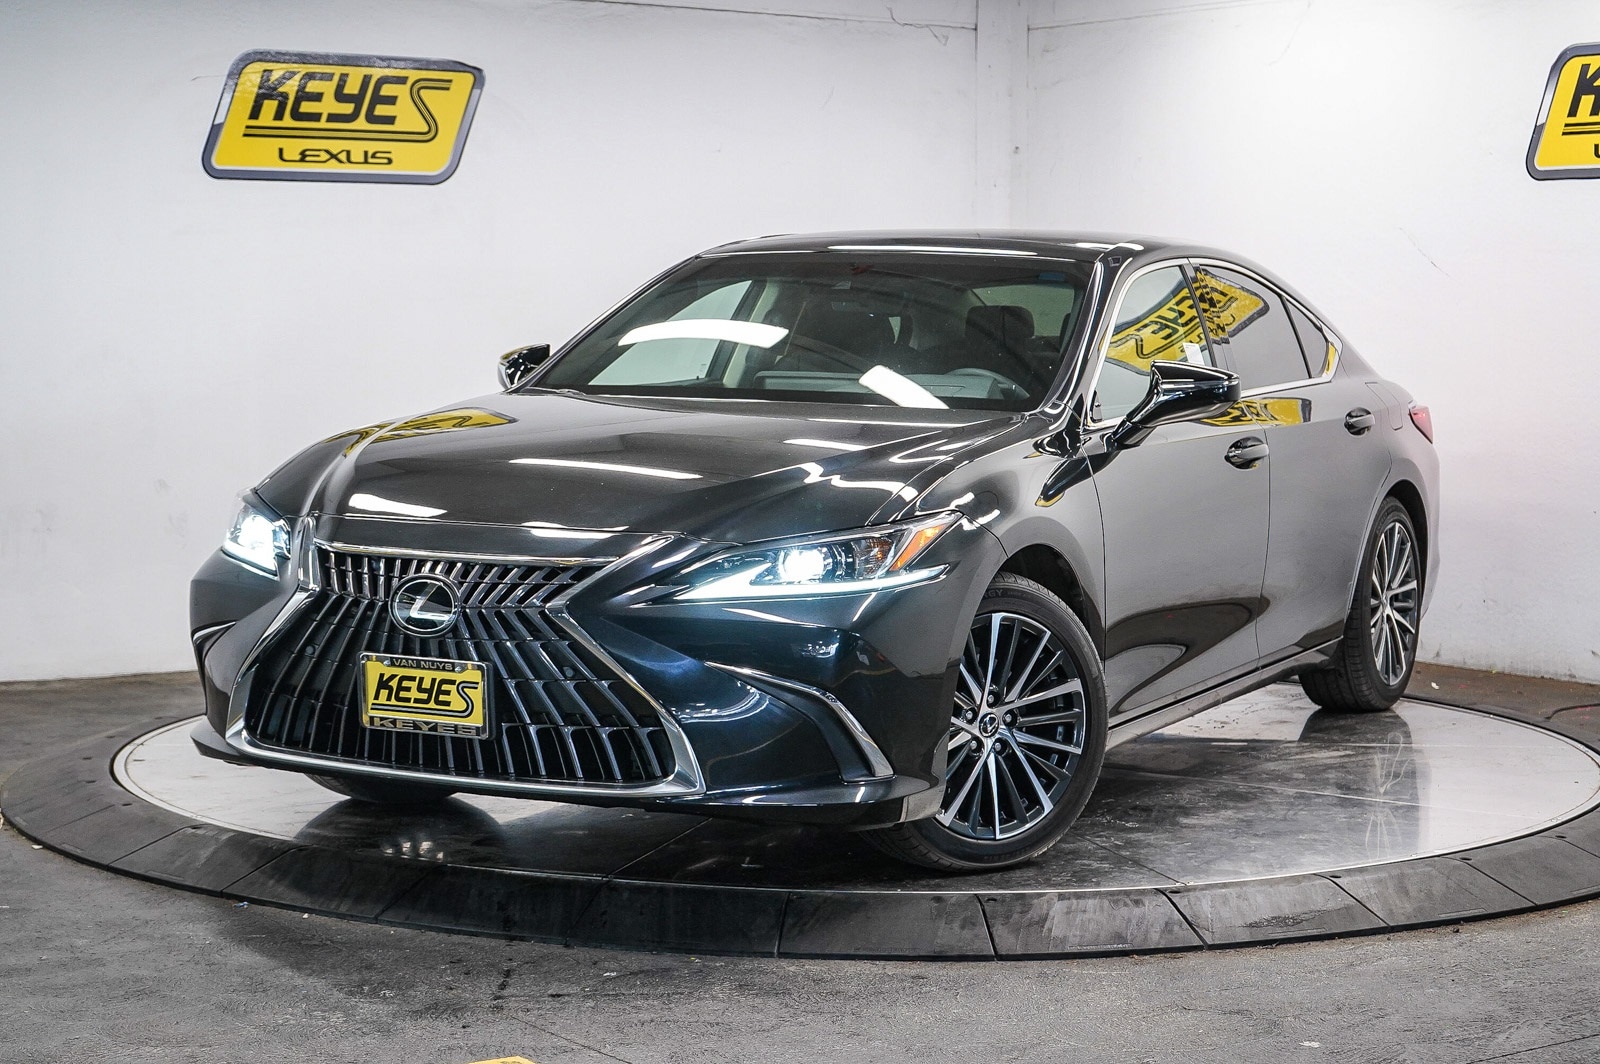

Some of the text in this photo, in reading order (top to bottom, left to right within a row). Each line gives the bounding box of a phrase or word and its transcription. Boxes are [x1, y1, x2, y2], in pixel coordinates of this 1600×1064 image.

[243, 68, 453, 143] KEYES
[278, 147, 393, 165] LEXUS
[393, 658, 453, 671] VAN NUYS
[370, 672, 480, 719] KEYES
[373, 717, 477, 736] KEYES
